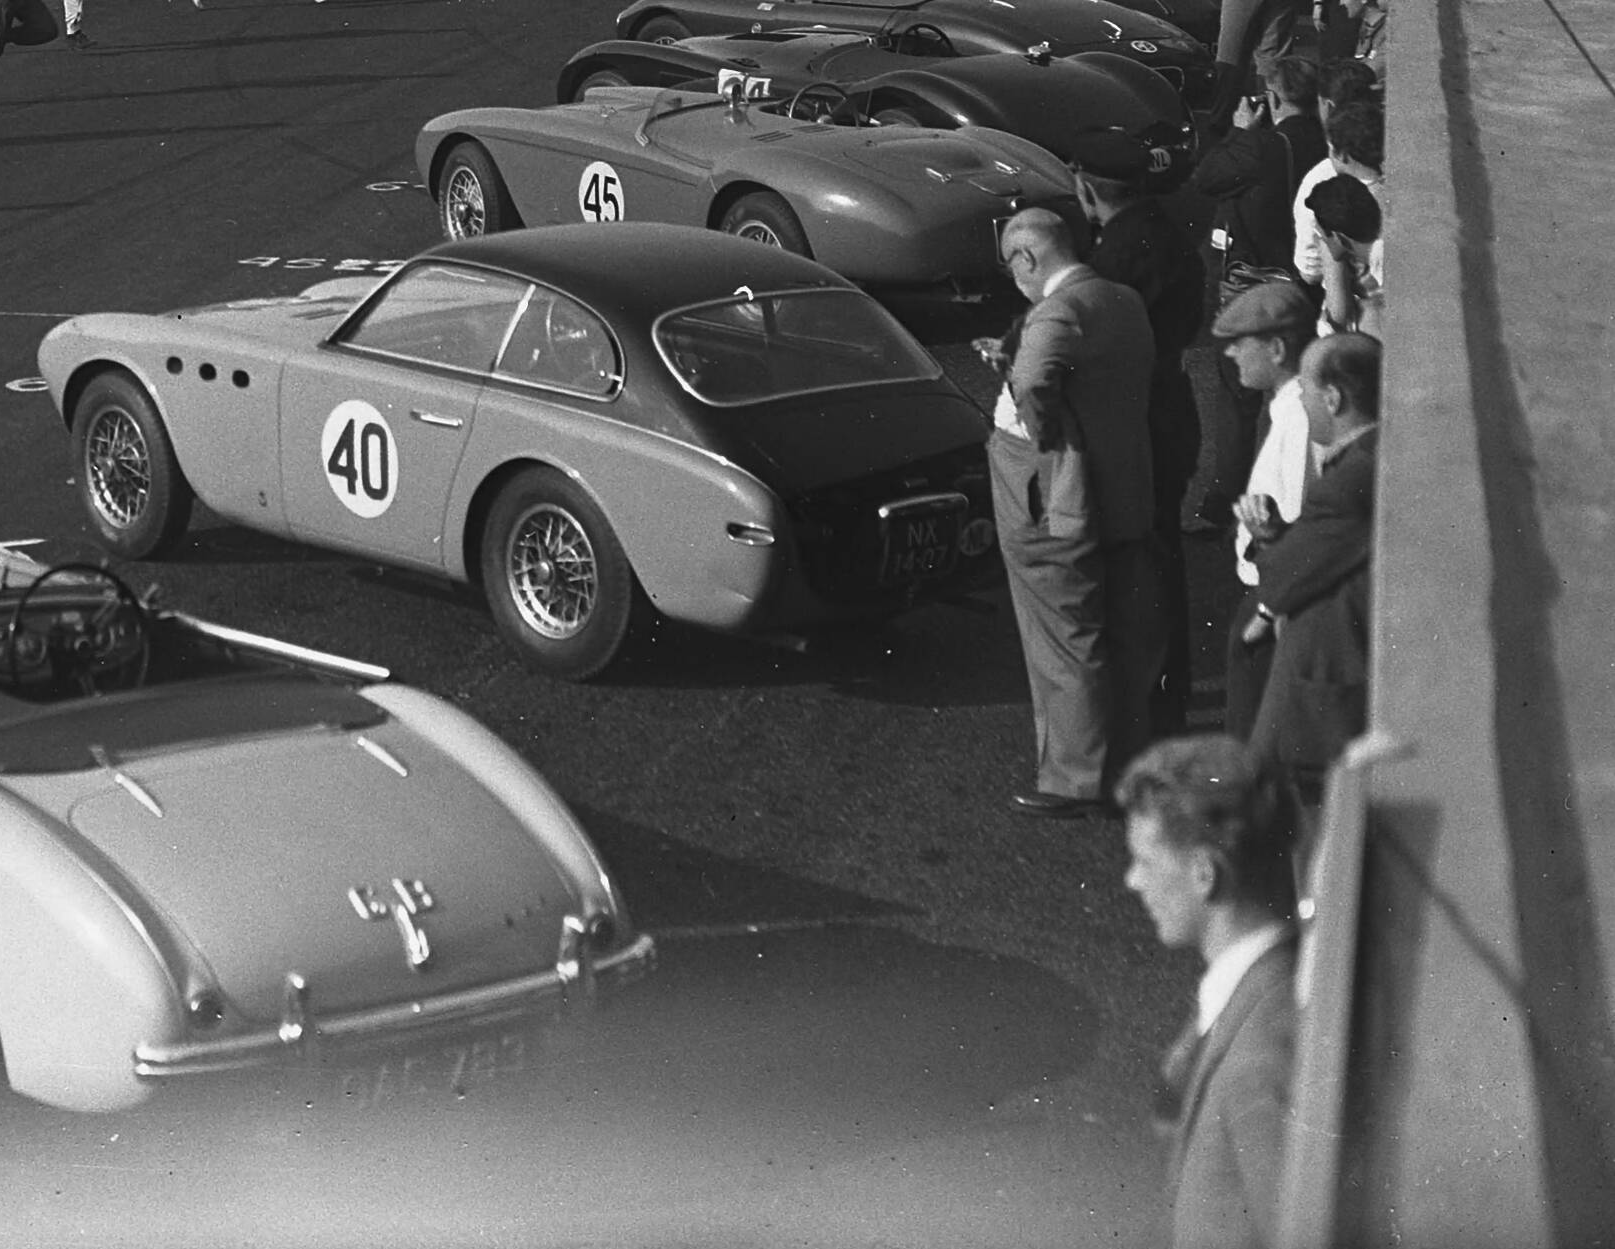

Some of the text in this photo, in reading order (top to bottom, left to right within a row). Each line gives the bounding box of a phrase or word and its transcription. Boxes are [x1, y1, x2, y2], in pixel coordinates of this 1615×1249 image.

[583, 173, 620, 221] 45
[327, 417, 390, 502] 40
[906, 518, 939, 547] NX
